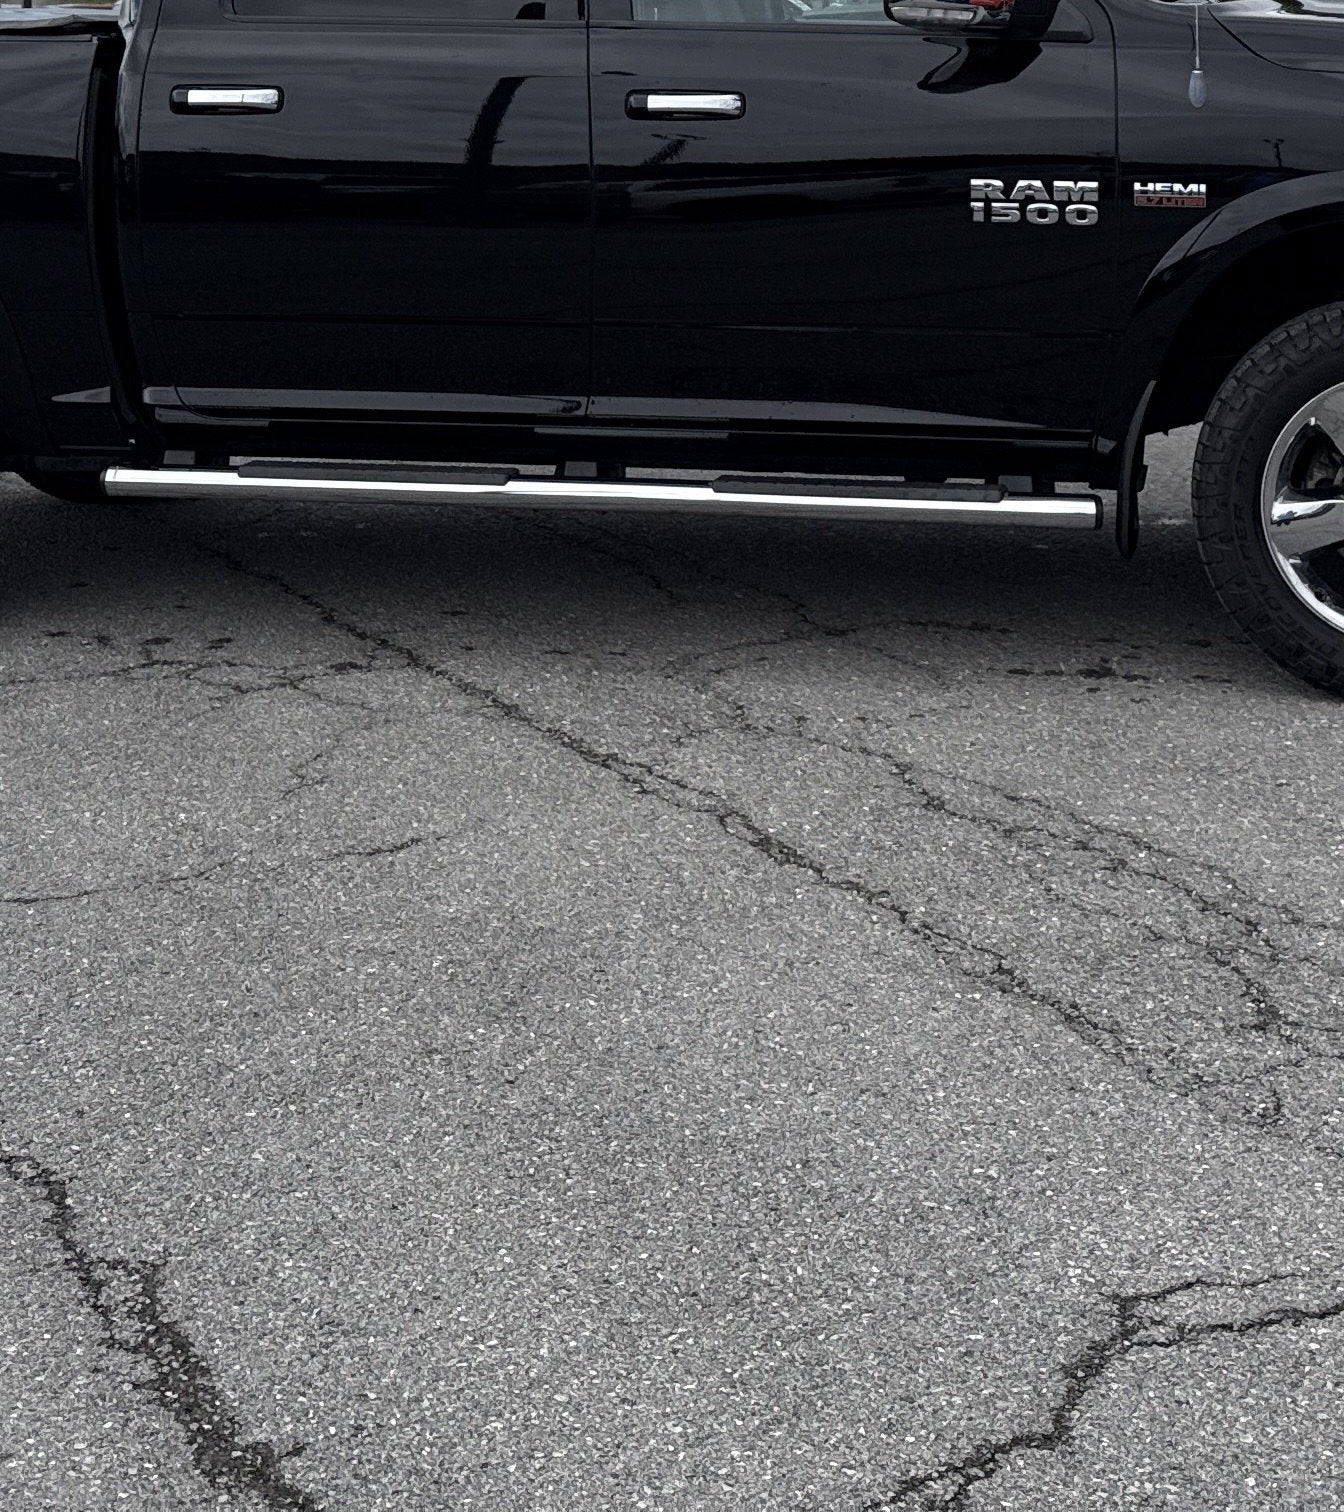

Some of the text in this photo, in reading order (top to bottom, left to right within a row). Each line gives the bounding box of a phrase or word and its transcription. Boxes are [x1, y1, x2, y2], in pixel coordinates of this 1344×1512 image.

[970, 178, 1099, 202] RAM
[1134, 182, 1207, 195] HEMI
[970, 202, 1099, 226] 1500
